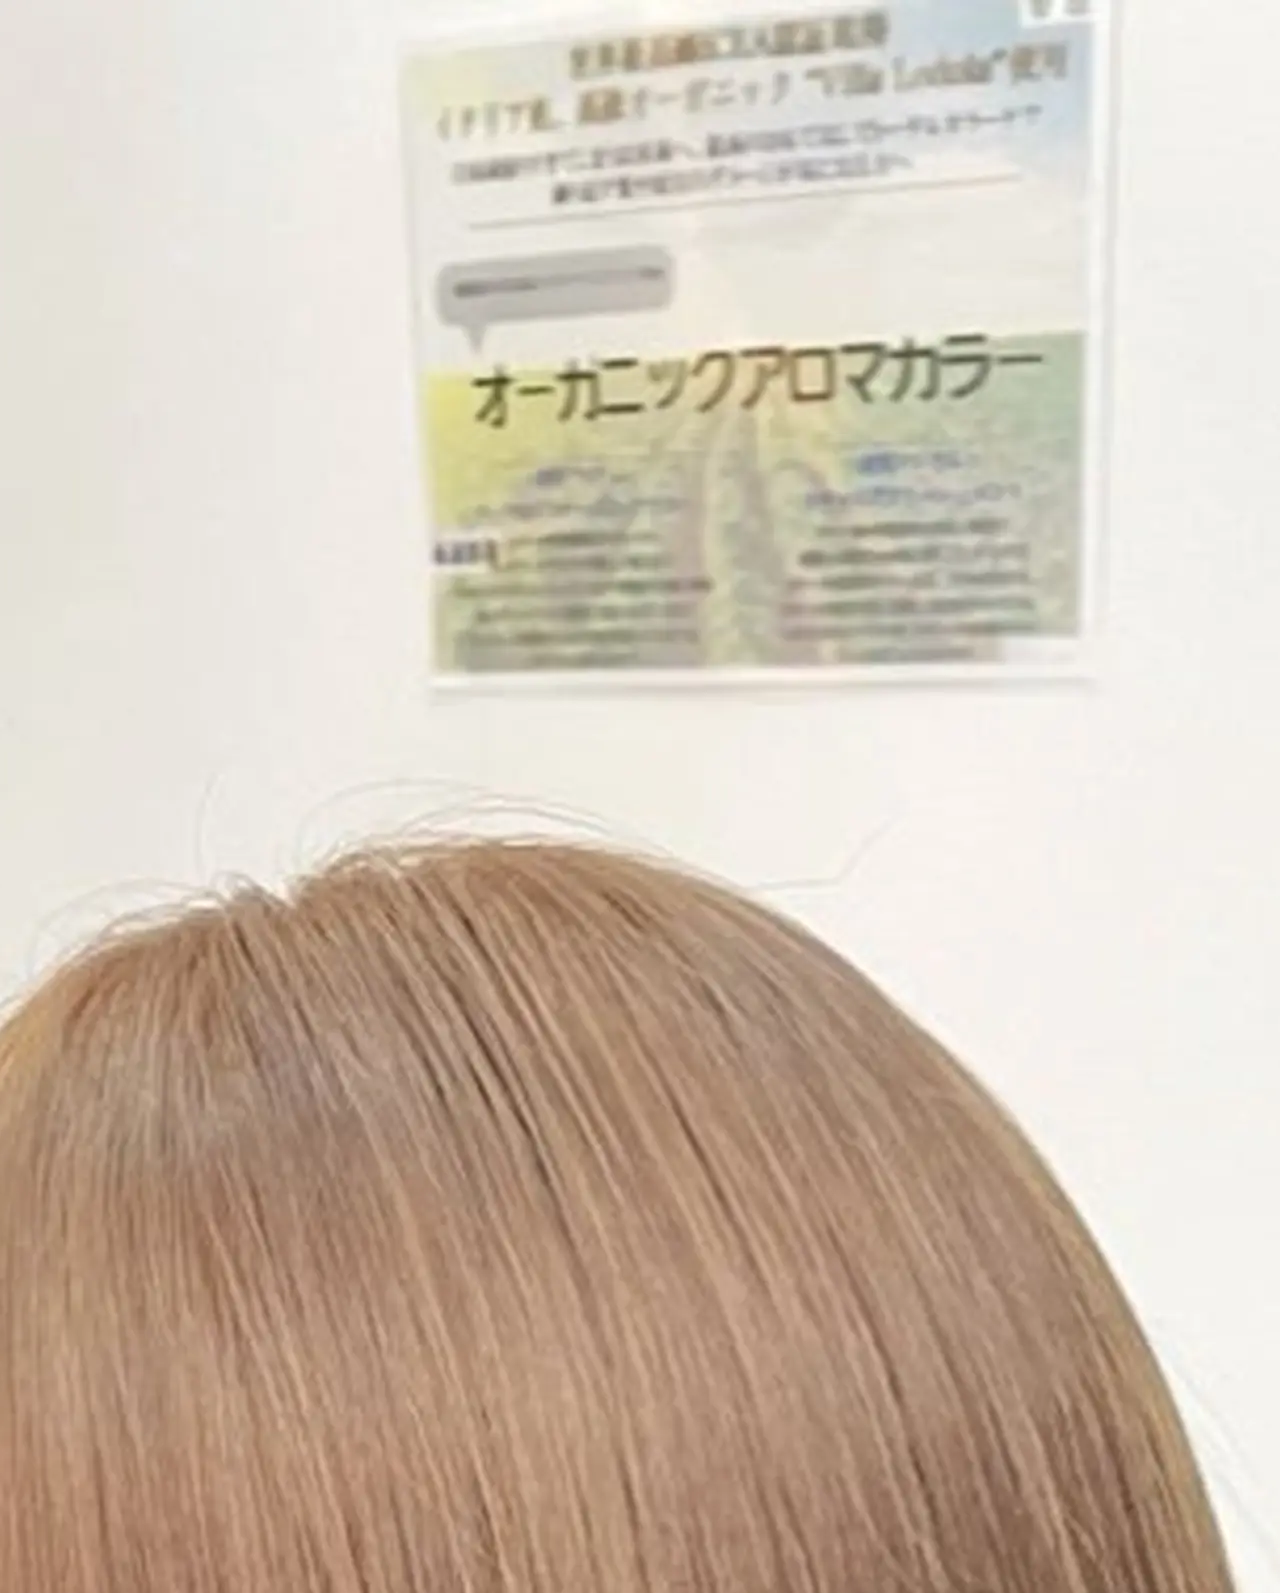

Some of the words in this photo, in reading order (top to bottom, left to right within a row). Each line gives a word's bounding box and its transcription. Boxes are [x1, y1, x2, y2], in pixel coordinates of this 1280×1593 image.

[472, 333, 1044, 428] オーガニックアロマカラー
